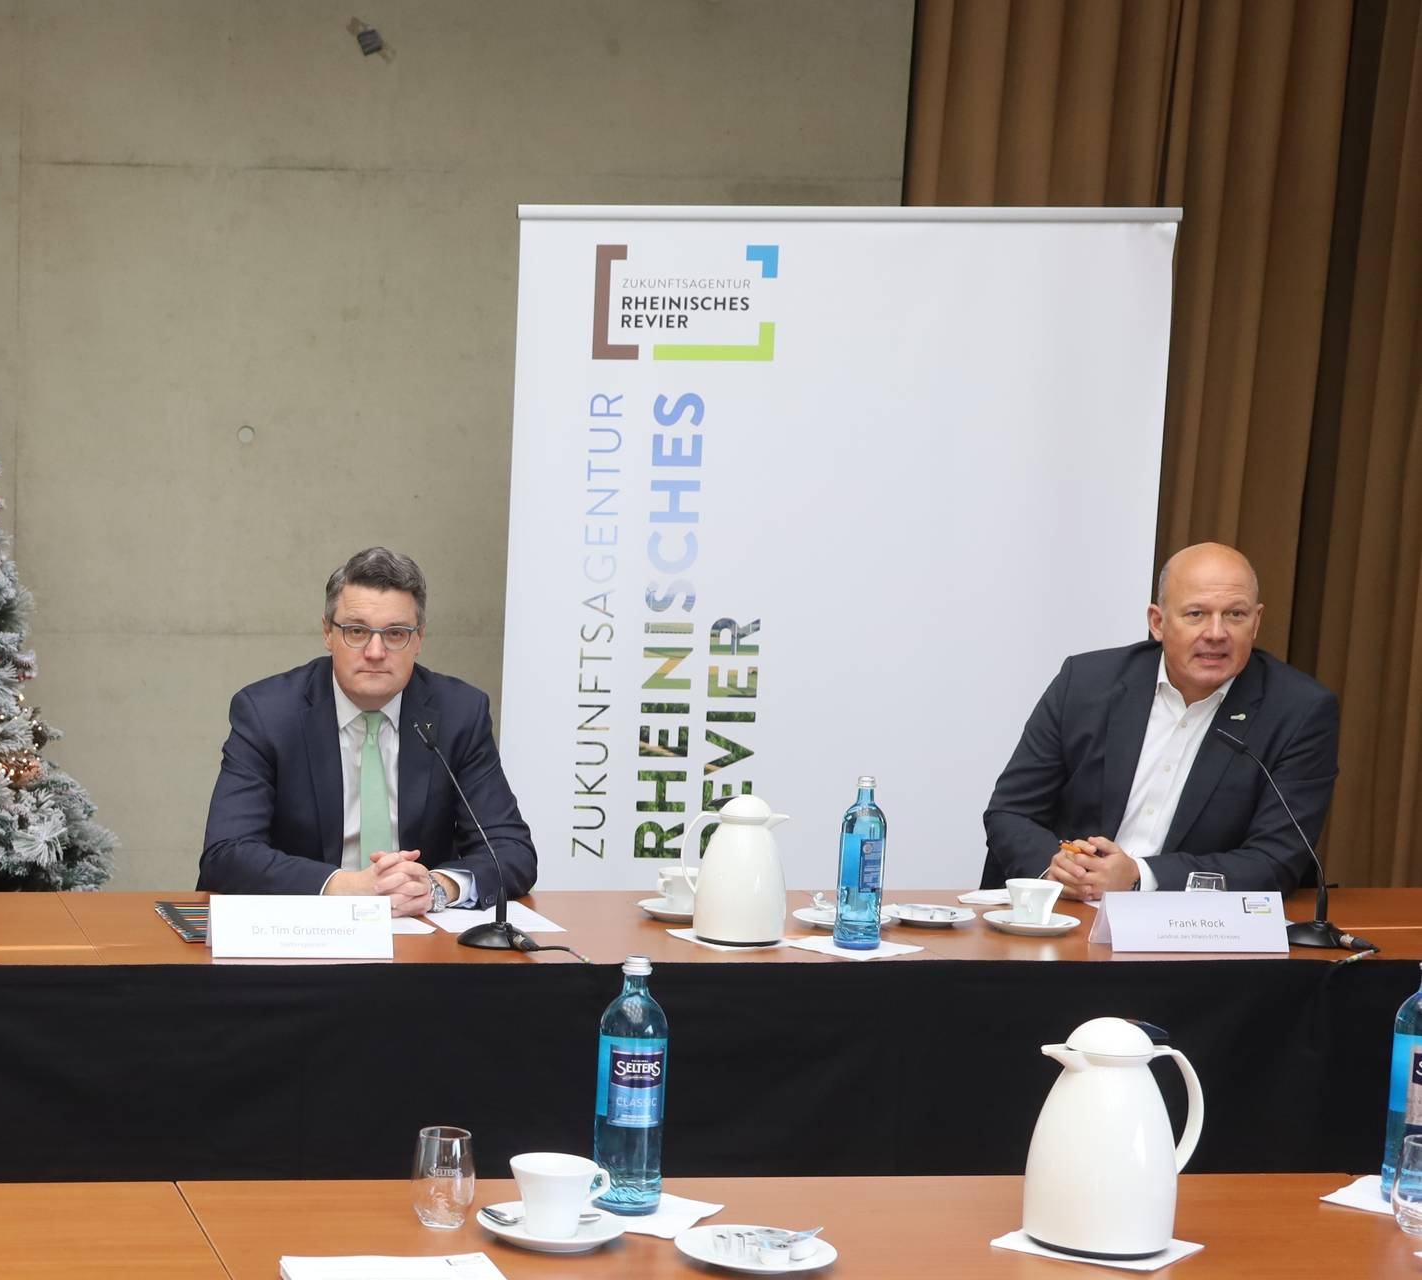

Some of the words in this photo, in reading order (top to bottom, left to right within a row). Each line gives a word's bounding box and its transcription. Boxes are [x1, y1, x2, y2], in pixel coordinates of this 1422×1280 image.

[622, 278, 751, 290] ZUKUNFTSAGENTUR
[621, 296, 750, 311] RHEINISCHES
[620, 314, 689, 329] REVIER
[571, 393, 623, 860] ZUKUNFTSAGENTUR
[634, 392, 705, 859] RHEINISCHES
[699, 617, 762, 859] EVIER
[271, 925, 290, 936] Tim
[1168, 919, 1198, 928] Frank
[1200, 919, 1226, 928] Rock
[616, 1096, 658, 1110] CLASC
